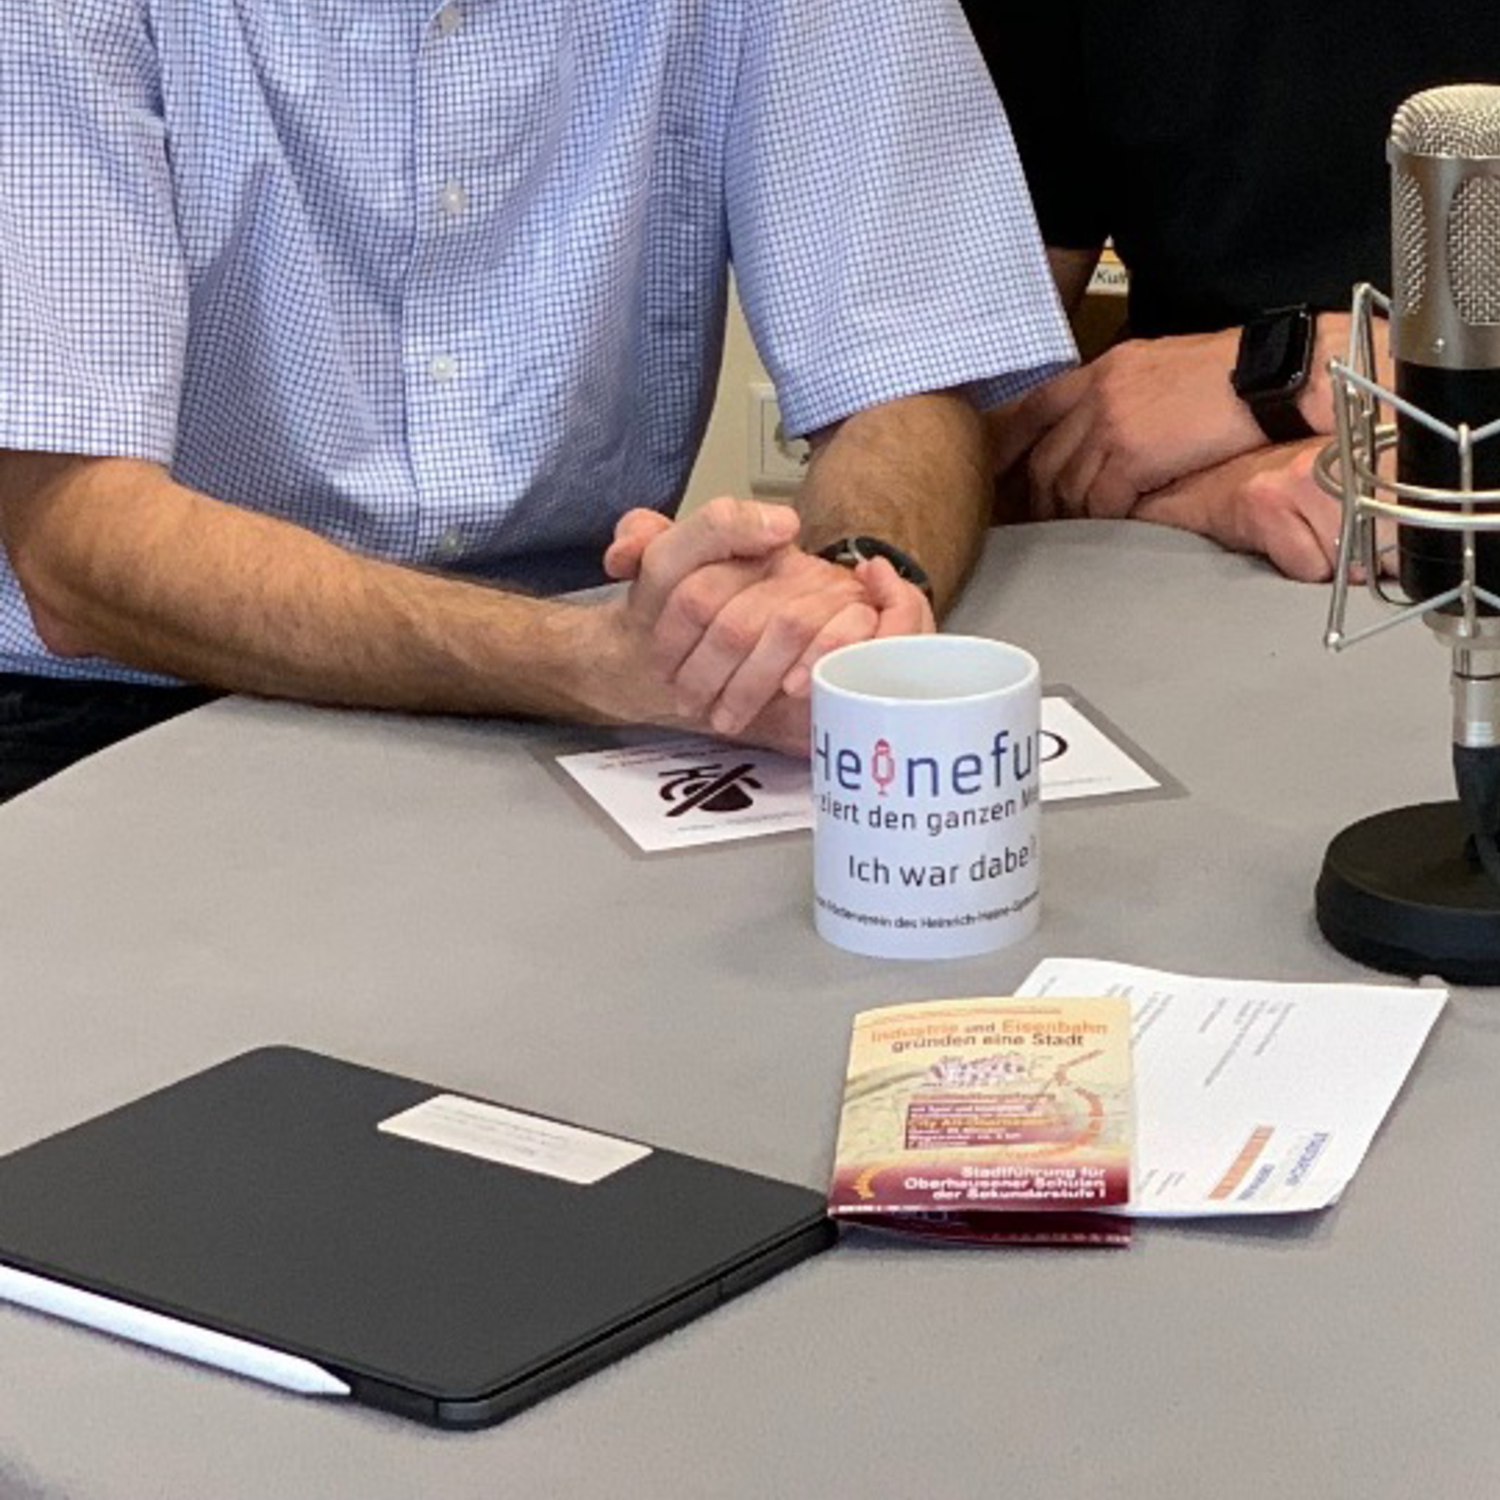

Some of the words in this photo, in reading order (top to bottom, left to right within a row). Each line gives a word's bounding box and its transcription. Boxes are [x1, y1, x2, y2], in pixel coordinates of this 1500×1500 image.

[868, 805, 917, 830] den
[926, 798, 1016, 837] ganzen
[848, 854, 891, 886] Ich
[899, 864, 959, 888] war
[894, 917, 918, 929] des
[871, 1021, 959, 1044] Industrie
[964, 1021, 997, 1035] und
[1001, 1019, 1109, 1035] Eisenbahn
[890, 1032, 976, 1054] gründen
[982, 1032, 1026, 1047] eine
[1031, 1031, 1084, 1047] Stadt
[960, 1164, 1077, 1182] Stadtführung
[1080, 1164, 1107, 1178] für
[903, 1176, 1025, 1191] Oberhausener
[1030, 1176, 1107, 1190] Schulen
[932, 1187, 962, 1200] der
[966, 1186, 1096, 1200] Sekundarstufe
